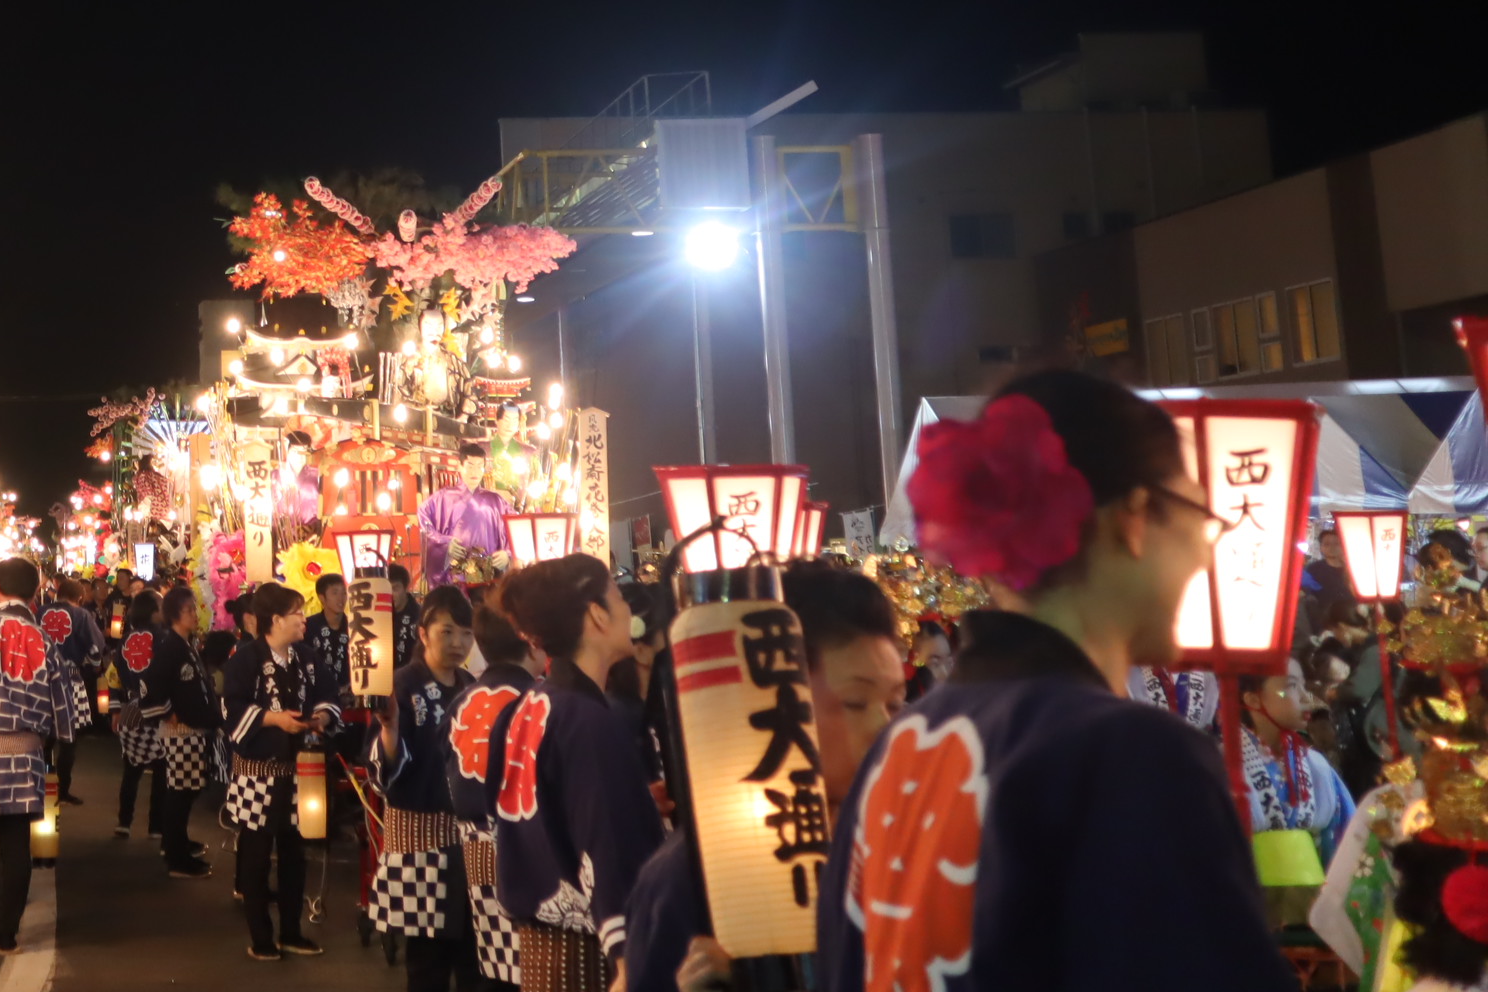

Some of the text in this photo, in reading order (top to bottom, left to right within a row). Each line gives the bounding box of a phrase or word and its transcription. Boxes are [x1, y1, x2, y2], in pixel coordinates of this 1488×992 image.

[246, 460, 270, 547] 西大通り
[348, 581, 379, 690] 西大通り
